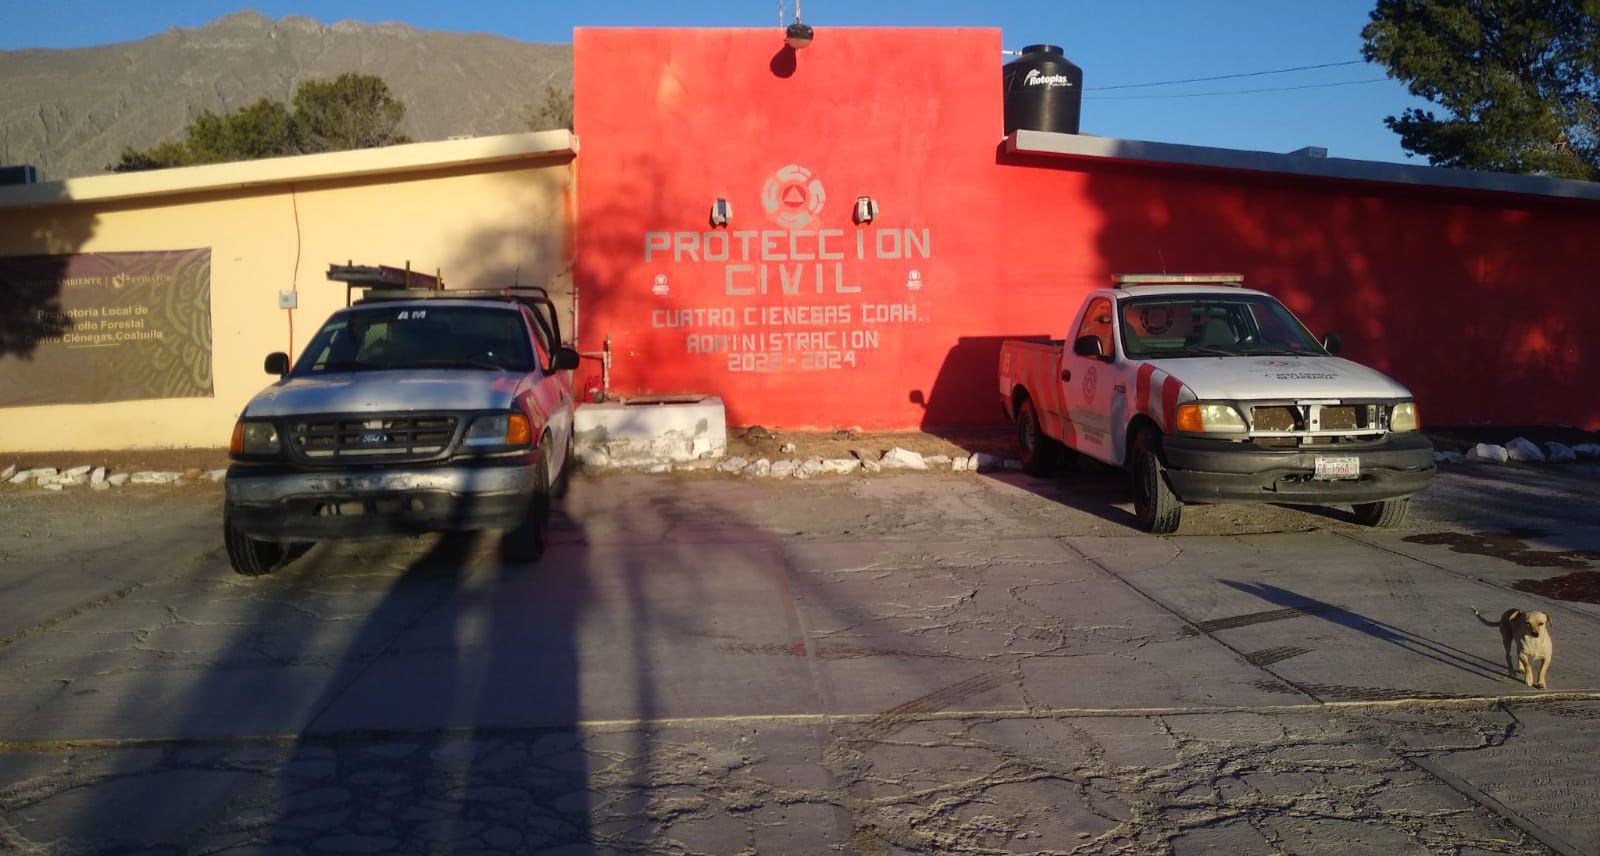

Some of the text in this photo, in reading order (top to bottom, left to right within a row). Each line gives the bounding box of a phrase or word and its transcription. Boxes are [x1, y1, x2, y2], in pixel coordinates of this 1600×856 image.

[1029, 74, 1068, 88] Rotoplas
[644, 228, 930, 262] PROTECCION
[725, 263, 861, 296] CIVIL
[102, 305, 131, 317] Local
[135, 306, 149, 316] de
[652, 308, 735, 328] CUATRO
[744, 305, 851, 325] CIENEGAS
[100, 318, 144, 331] Forestal
[687, 330, 880, 353] ADMINISTRACION
